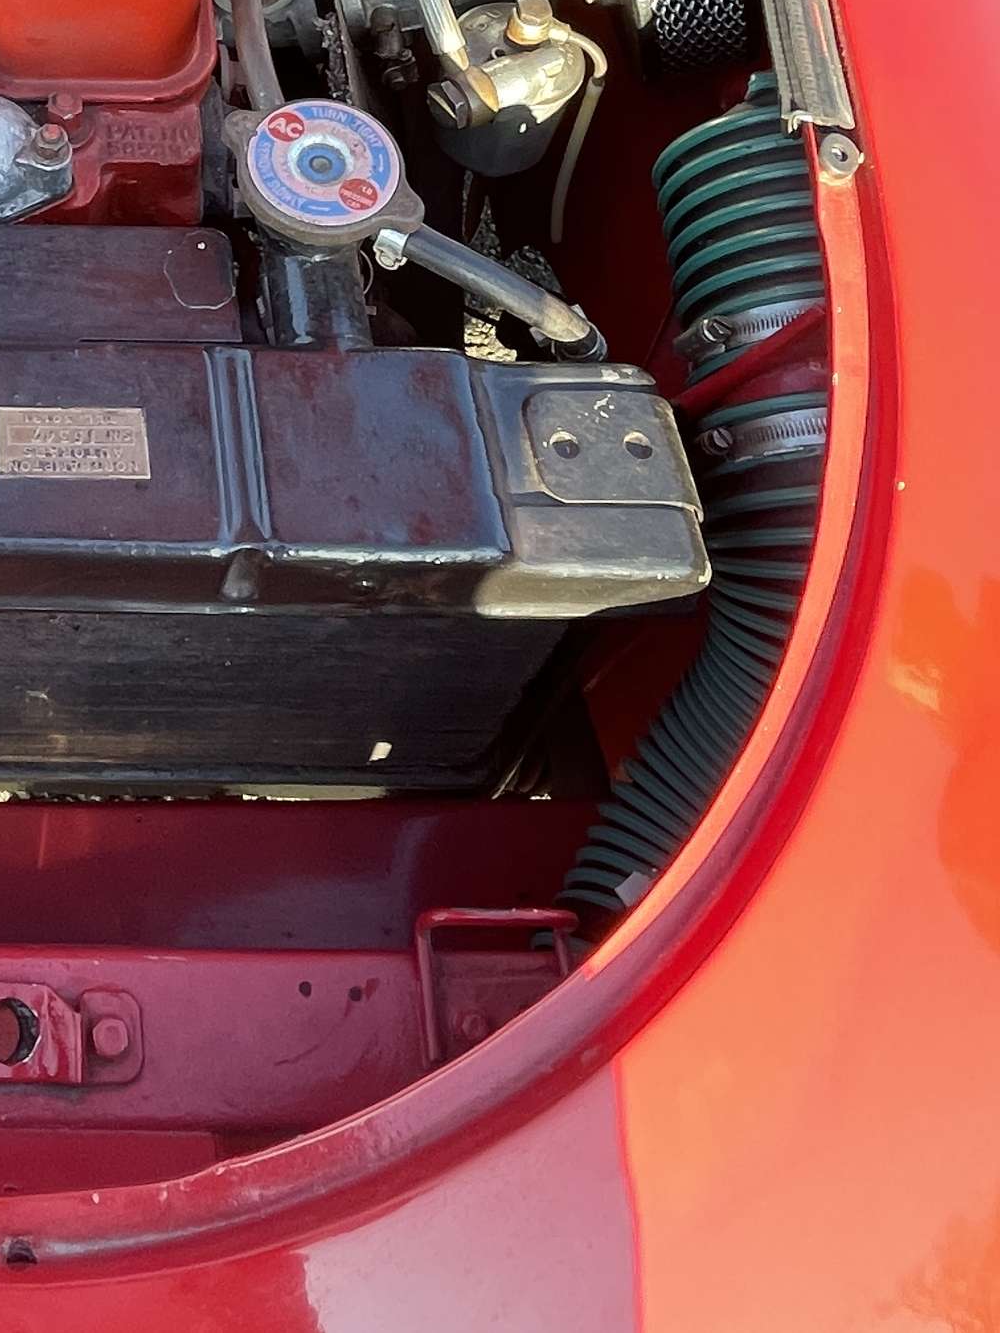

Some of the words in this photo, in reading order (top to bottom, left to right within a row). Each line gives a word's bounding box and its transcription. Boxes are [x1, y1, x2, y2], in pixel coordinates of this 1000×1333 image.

[268, 118, 304, 138] AC
[312, 107, 348, 123] TURN
[352, 116, 382, 148] TIGHT
